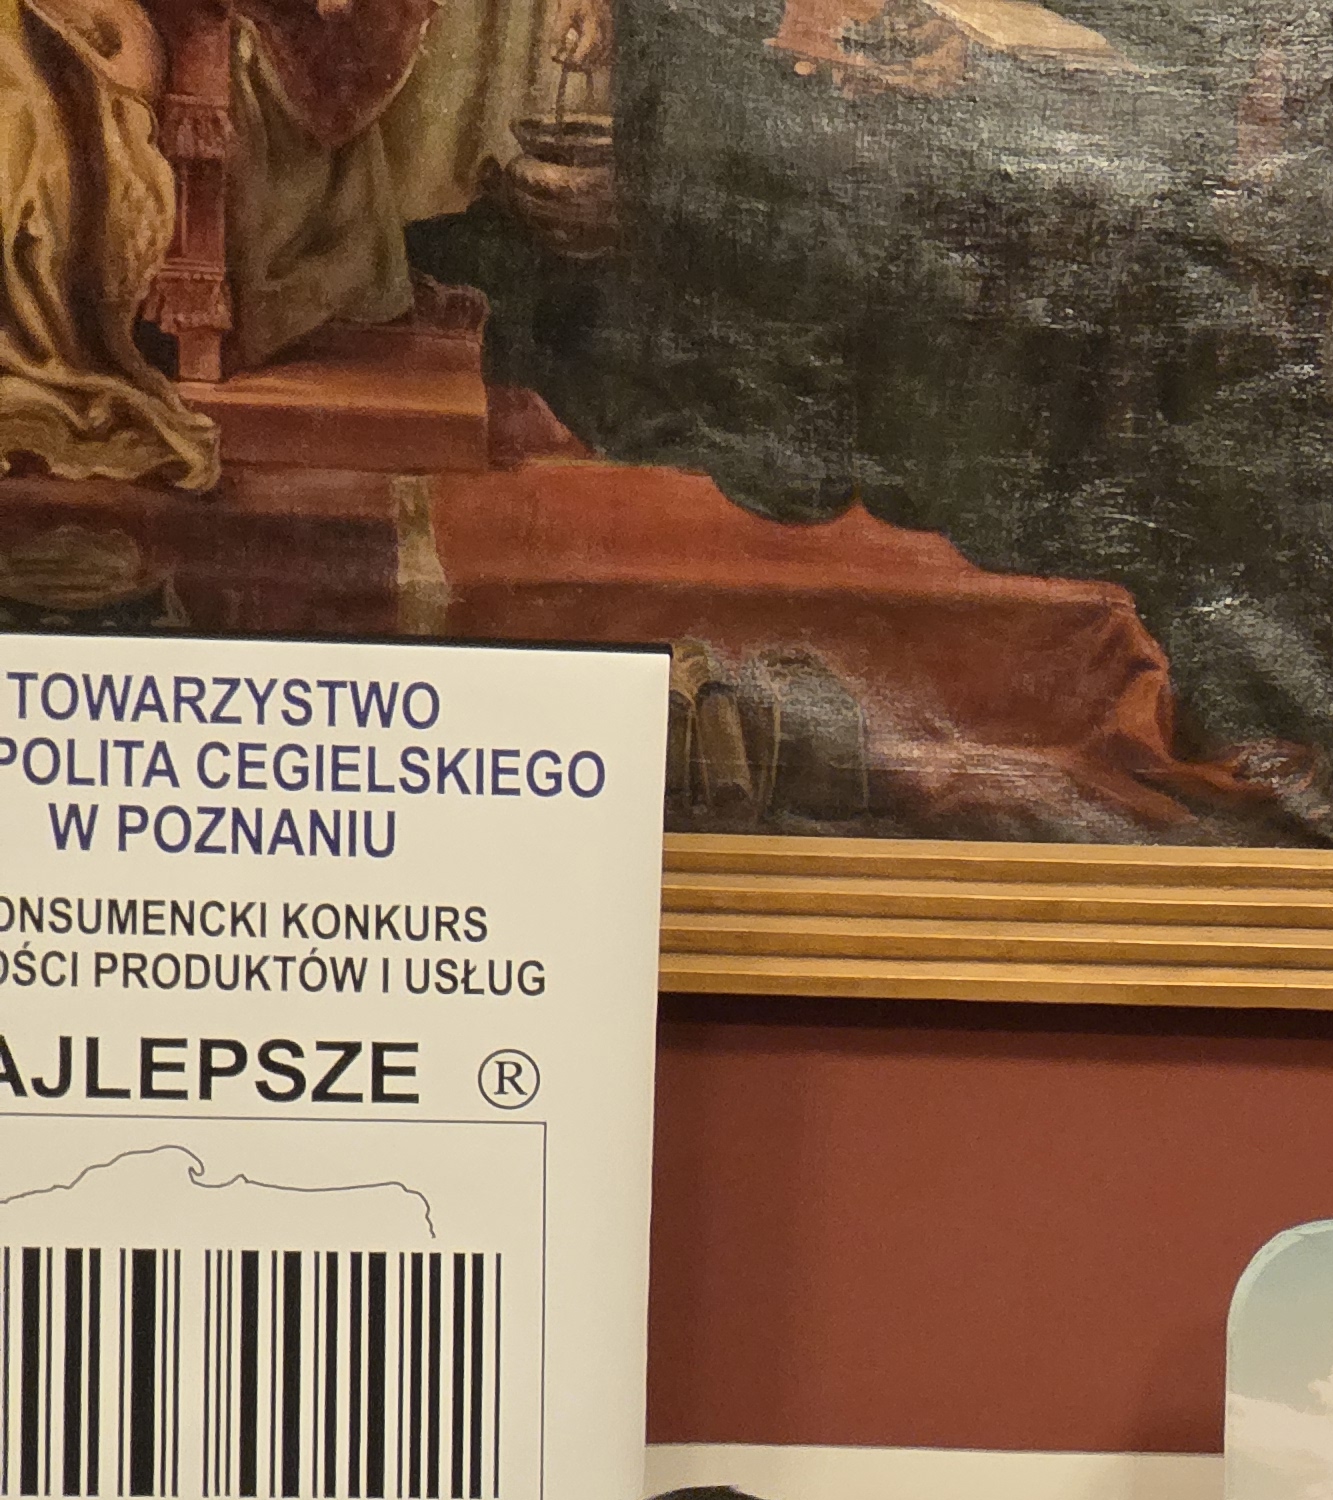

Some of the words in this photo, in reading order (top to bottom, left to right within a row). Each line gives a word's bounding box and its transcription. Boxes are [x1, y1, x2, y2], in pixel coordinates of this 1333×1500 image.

[7, 671, 440, 730] TOWARZYSTWO
[196, 741, 606, 799] CEGIELSKIEGO
[48, 802, 99, 851] W
[118, 804, 396, 858] POZNANIU
[283, 902, 488, 943] KONKURS
[0, 941, 78, 988] ŚCI
[94, 947, 368, 993] PRODUKTÓW
[382, 957, 390, 993] I
[405, 957, 546, 997] USŁUG
